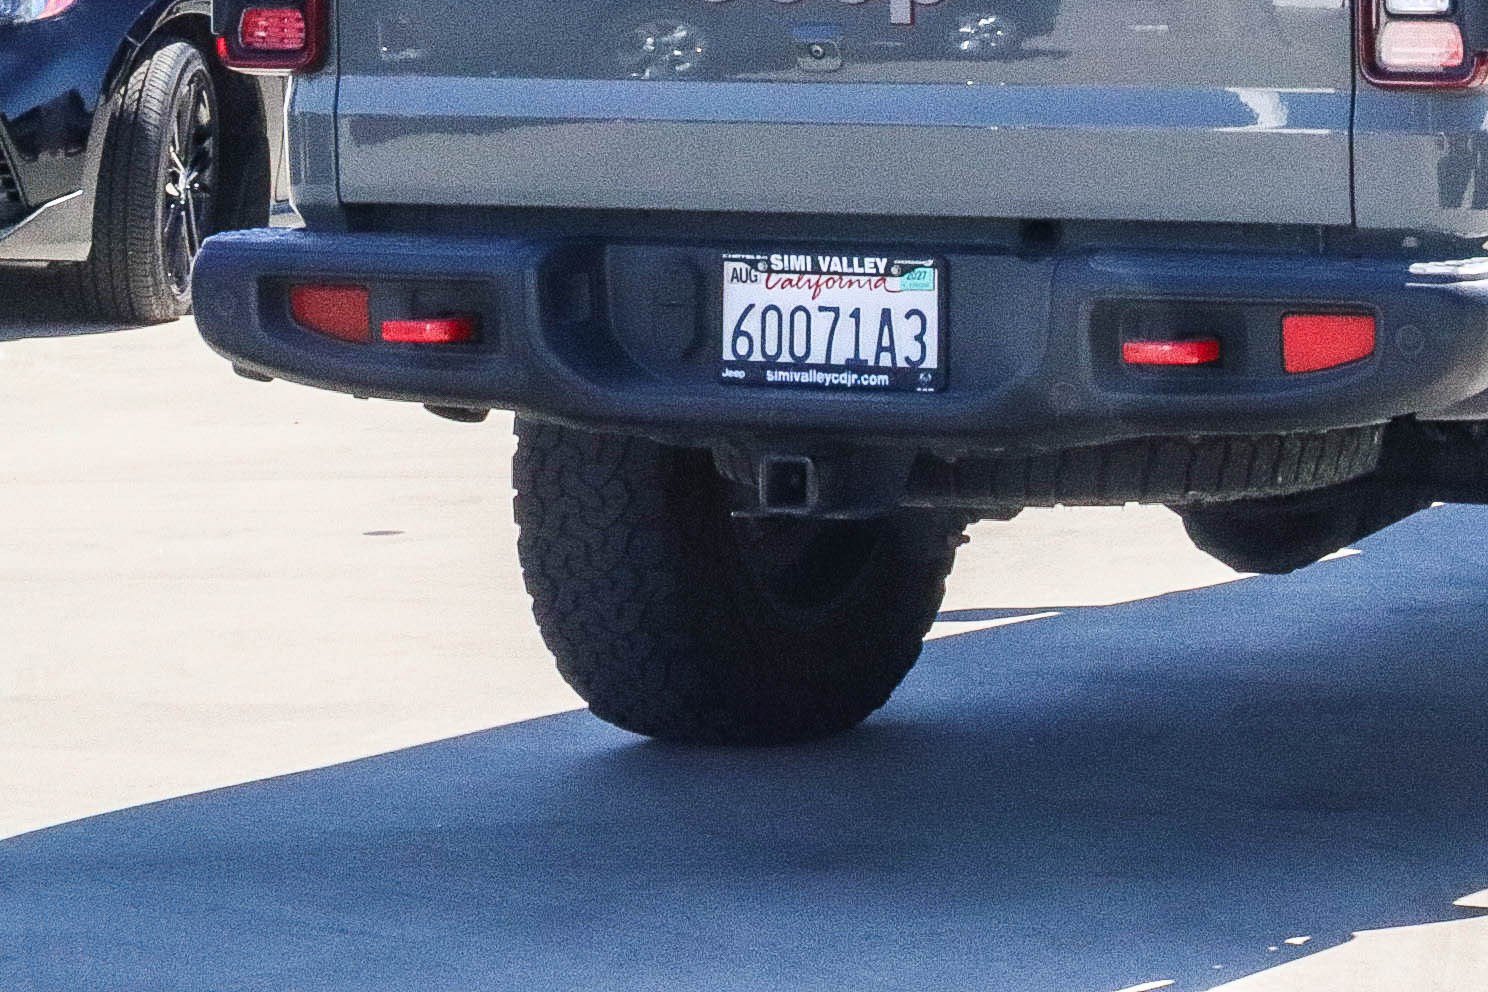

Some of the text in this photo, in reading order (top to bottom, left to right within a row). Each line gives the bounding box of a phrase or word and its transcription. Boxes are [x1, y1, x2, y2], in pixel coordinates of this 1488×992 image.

[769, 253, 888, 274] SIMI VALLEY
[730, 267, 758, 283] AUG
[765, 272, 903, 301] California
[731, 303, 927, 368] 60071A3
[766, 369, 889, 387] simivalleycdjr.com
